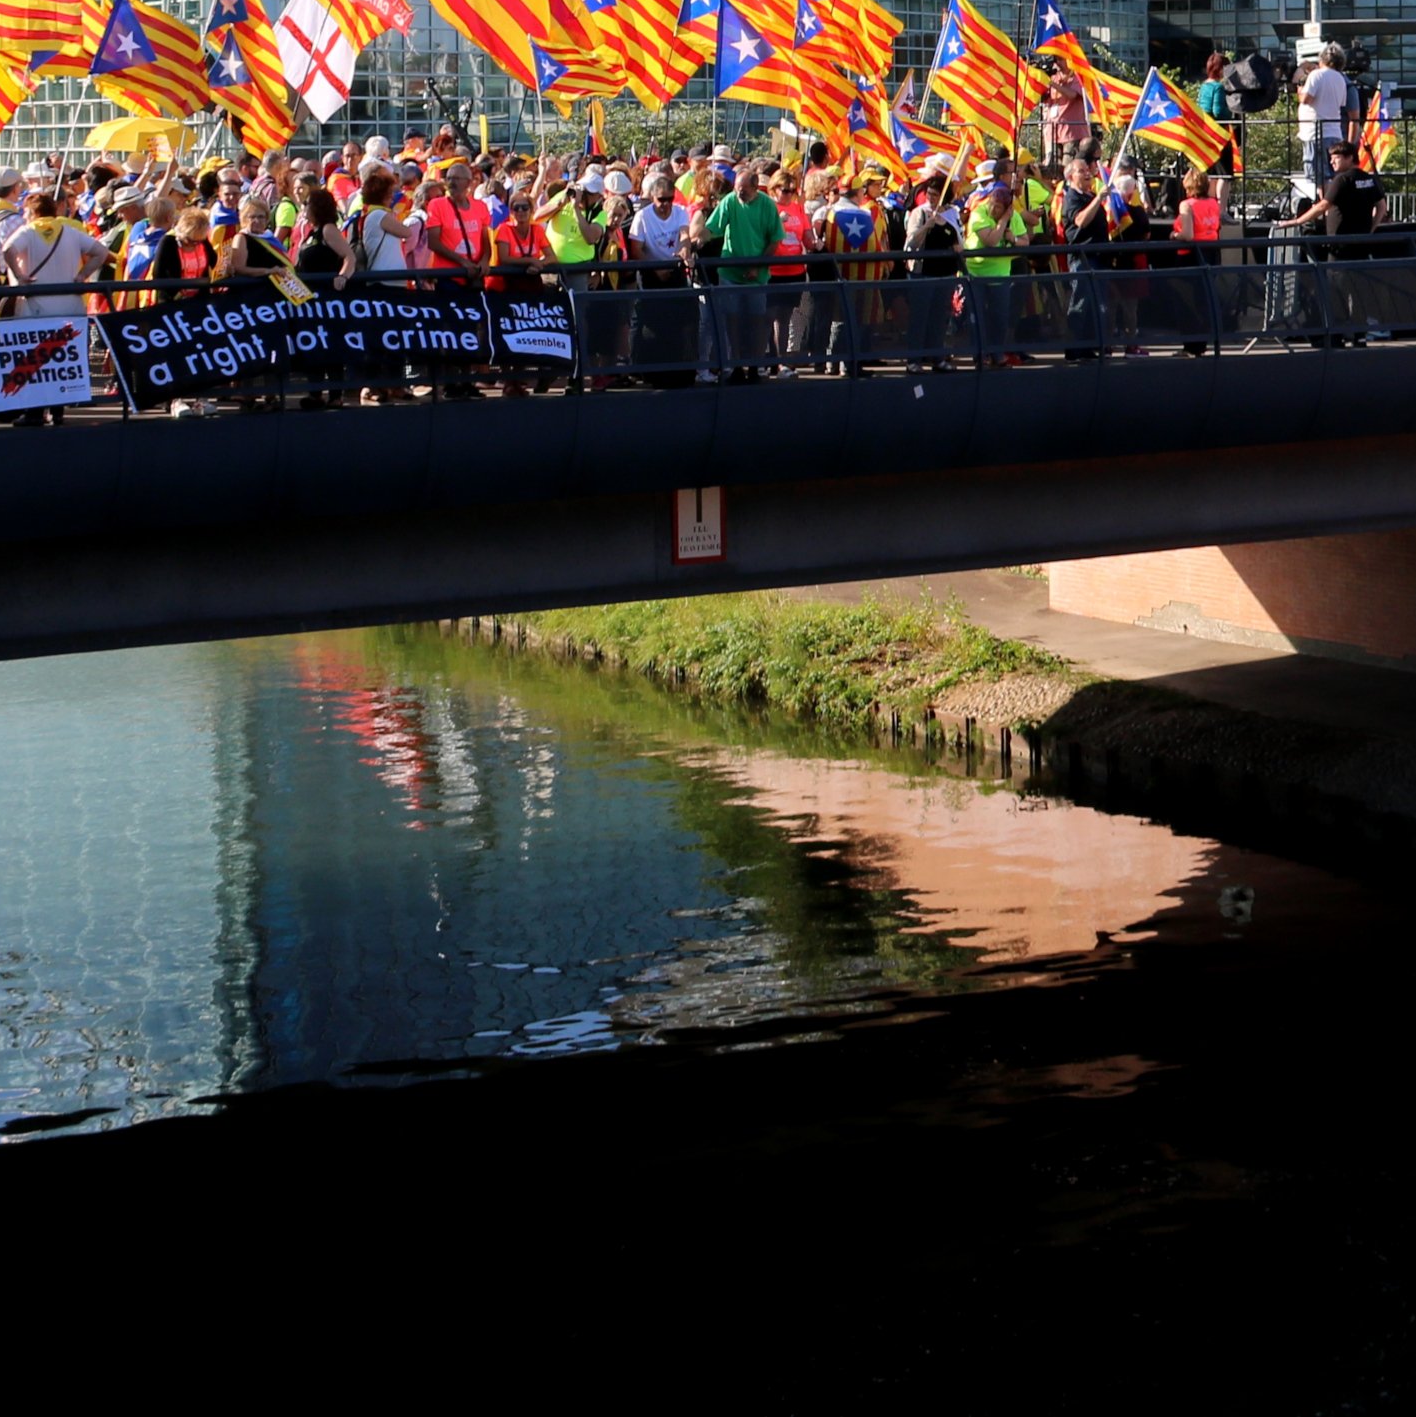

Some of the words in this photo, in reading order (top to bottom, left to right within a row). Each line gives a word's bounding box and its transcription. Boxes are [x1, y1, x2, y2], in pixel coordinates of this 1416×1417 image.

[449, 301, 481, 321] is
[509, 302, 565, 319] Make
[516, 336, 567, 350] assemblea
[149, 360, 175, 386] a
[344, 331, 365, 351] a
[382, 322, 480, 352] crime
